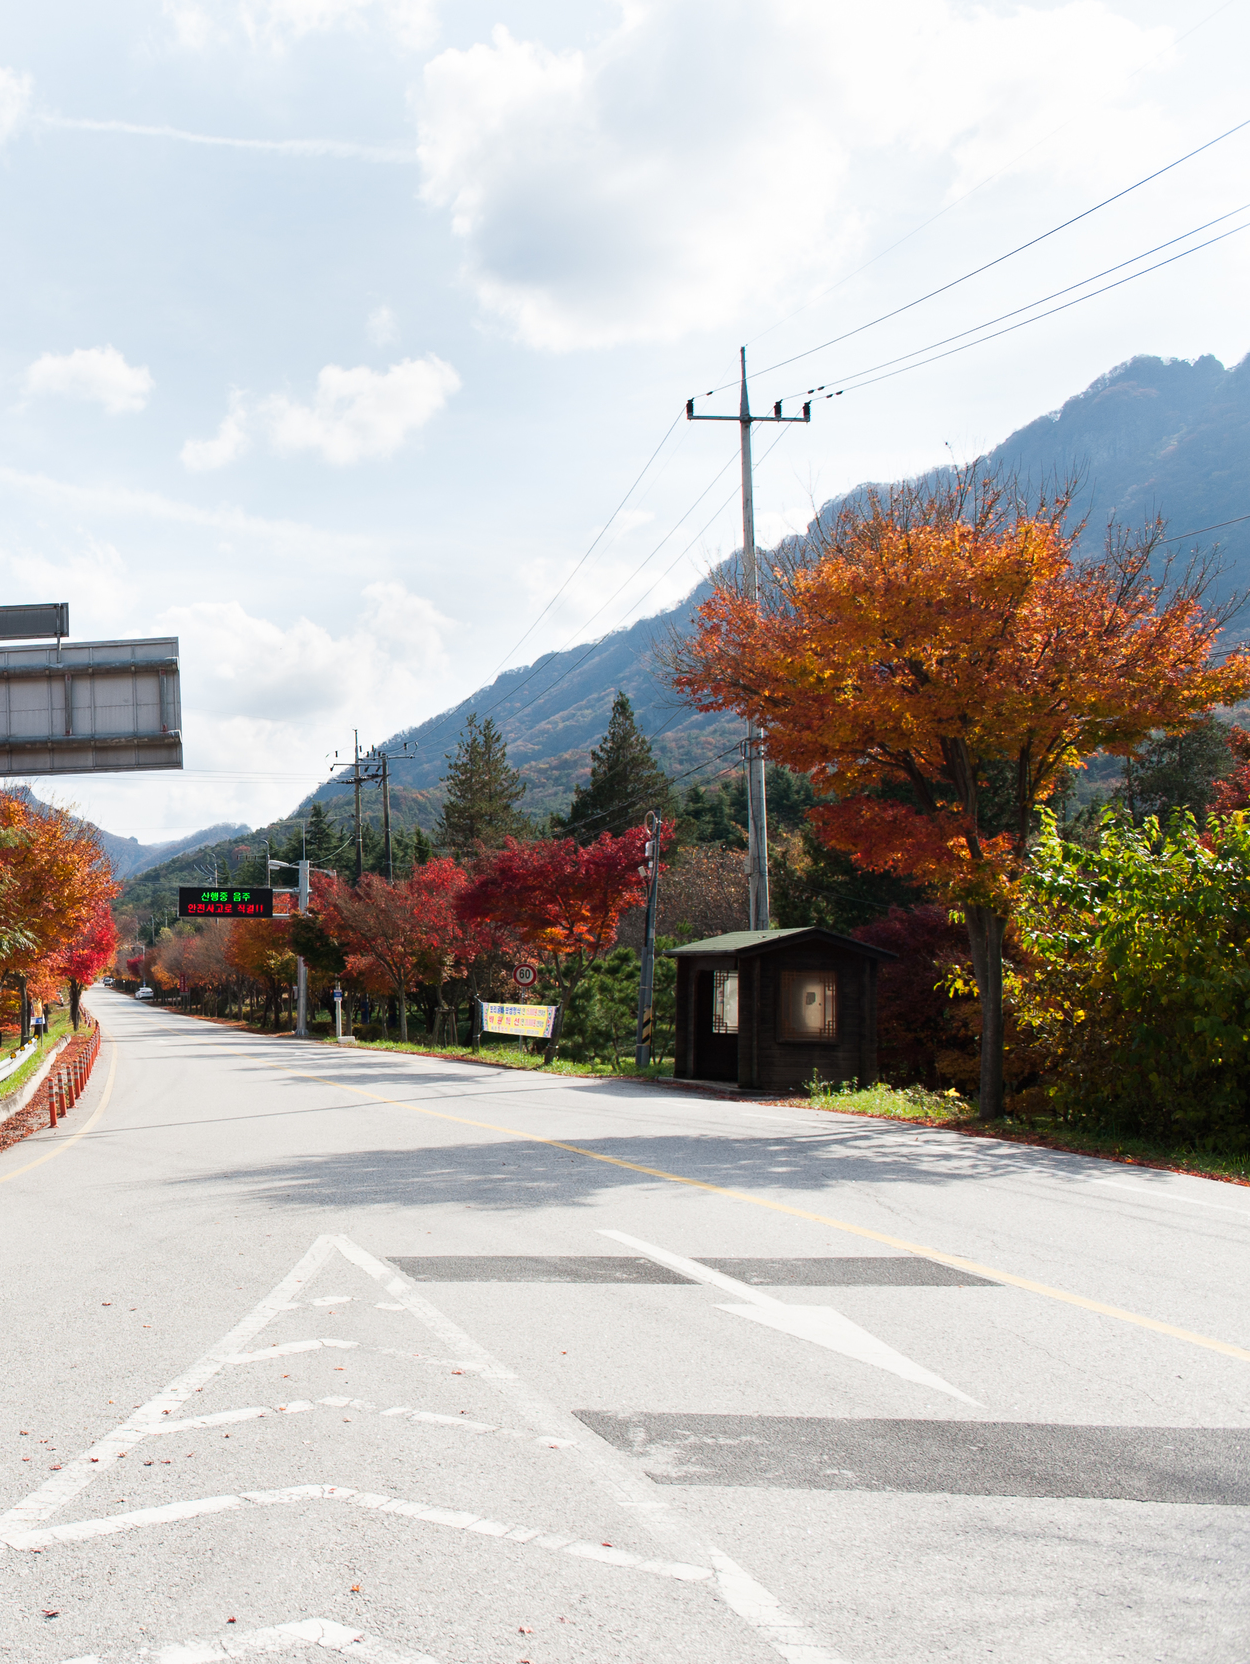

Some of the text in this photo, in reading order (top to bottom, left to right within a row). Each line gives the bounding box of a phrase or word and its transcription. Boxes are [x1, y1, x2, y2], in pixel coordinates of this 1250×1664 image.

[201, 891, 251, 902] 산행중 음주
[187, 903, 264, 915] 안전사고로 직결!!
[519, 969, 531, 979] 60
